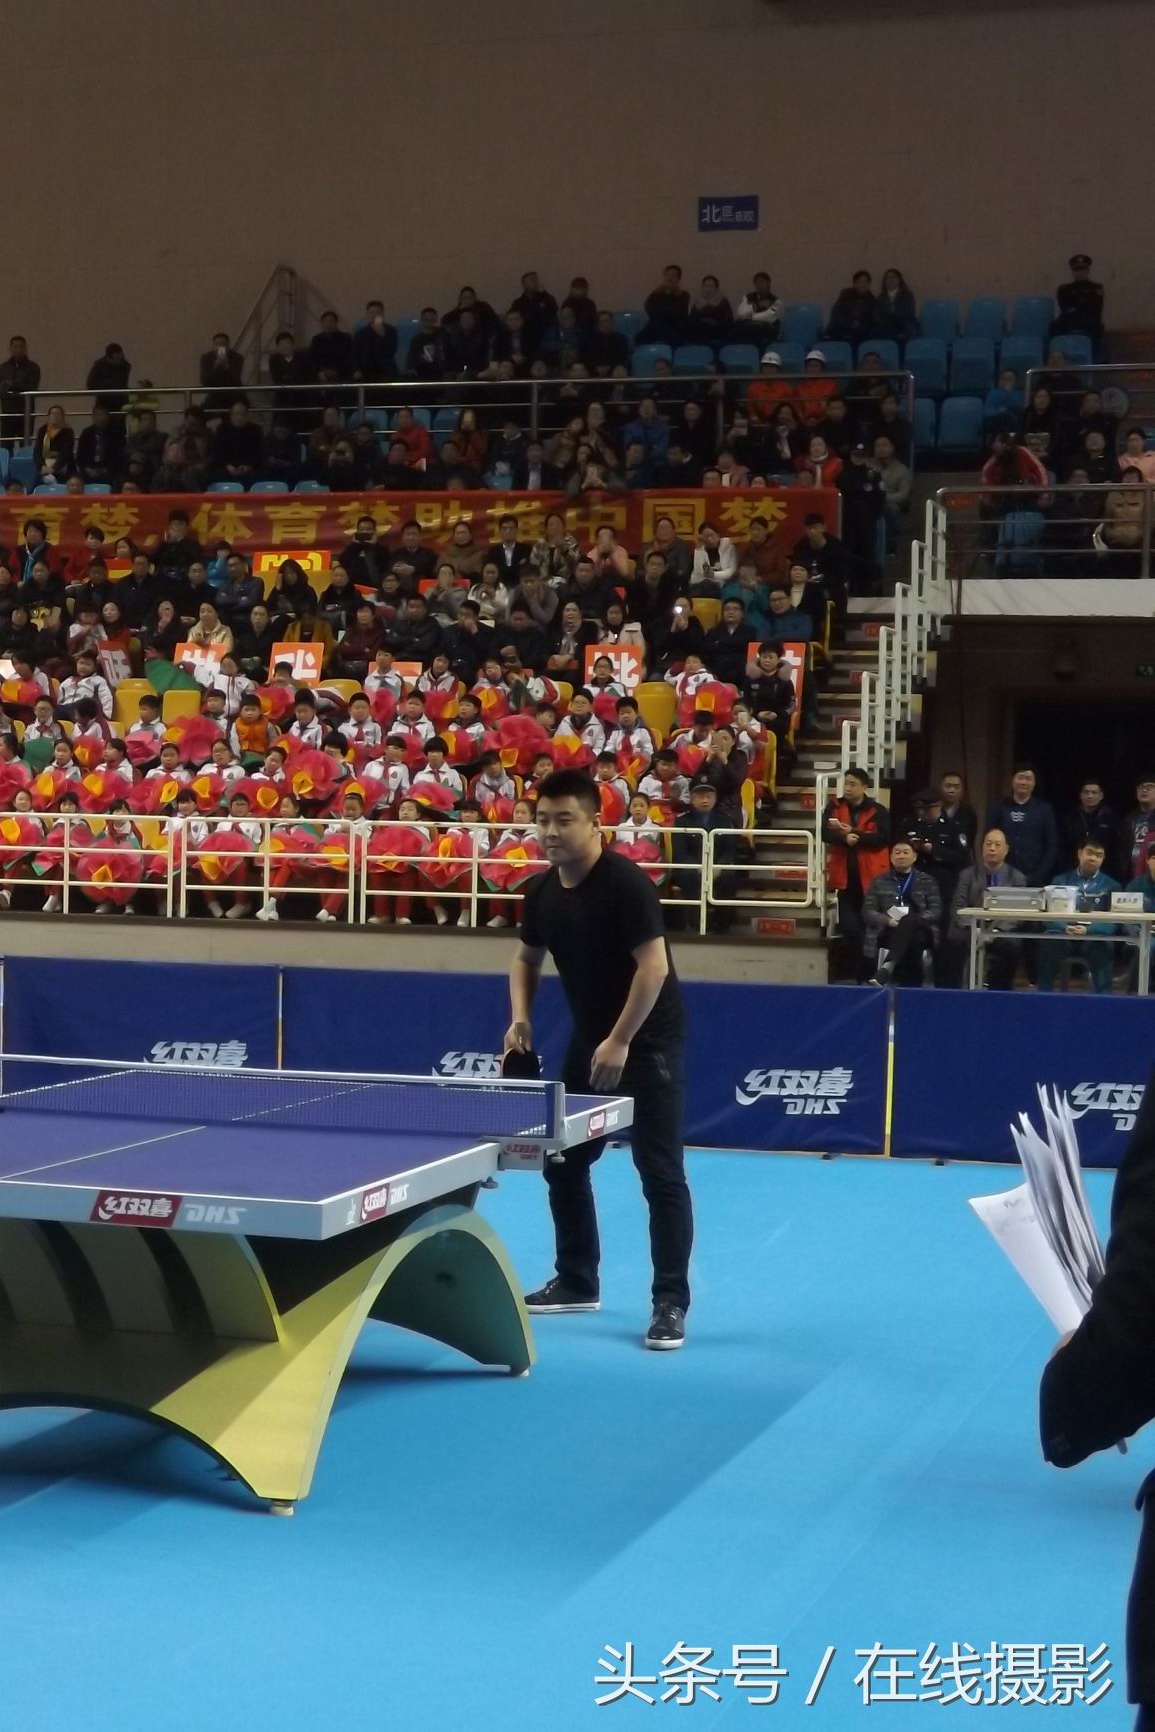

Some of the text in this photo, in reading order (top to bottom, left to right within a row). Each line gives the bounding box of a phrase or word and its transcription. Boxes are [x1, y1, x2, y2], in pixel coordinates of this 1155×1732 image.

[143, 1040, 248, 1068] 红双喜
[432, 1051, 543, 1078] 红双
[735, 1066, 854, 1106] 红双喜
[782, 1098, 847, 1115] DHS
[98, 1195, 173, 1220] 红双喜
[183, 1203, 248, 1225] DHS
